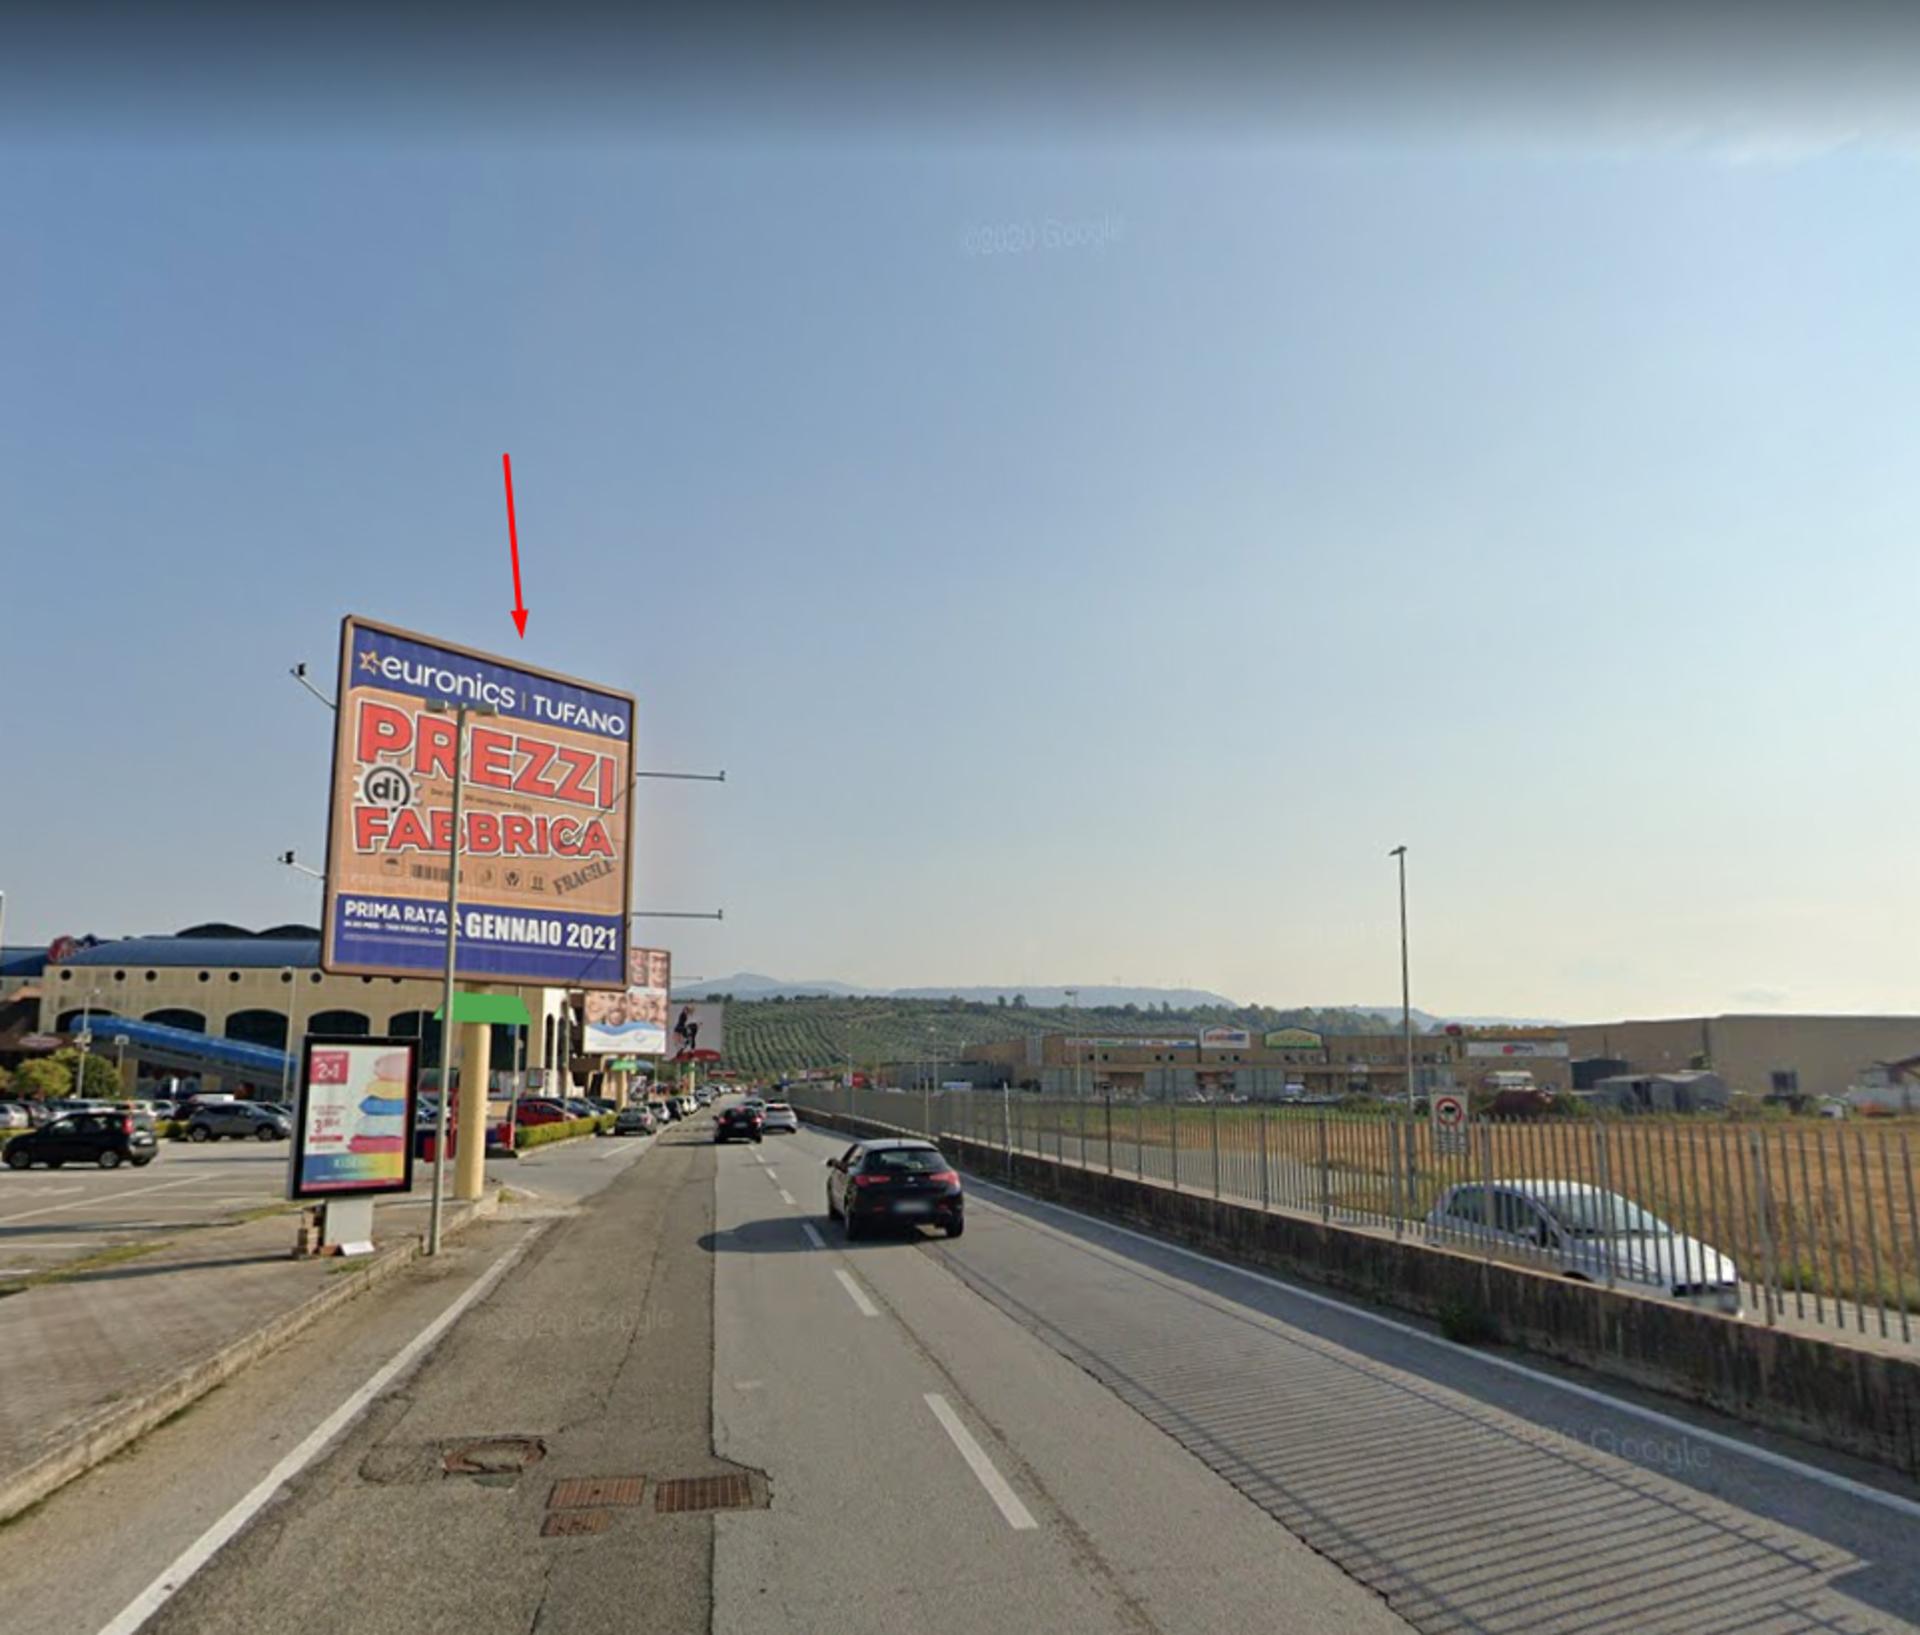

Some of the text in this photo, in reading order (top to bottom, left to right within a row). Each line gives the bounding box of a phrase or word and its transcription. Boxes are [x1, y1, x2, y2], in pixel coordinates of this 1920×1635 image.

[381, 656, 625, 735] euronics TUFANO
[355, 699, 616, 812] PREZZI
[372, 778, 400, 806] di
[353, 805, 616, 859] FABBRICA
[553, 858, 615, 895] FRAGILE
[344, 900, 401, 921] PRIMA
[404, 905, 448, 925] RATA
[465, 912, 561, 949] GENNAIO
[566, 923, 616, 950] 2021
